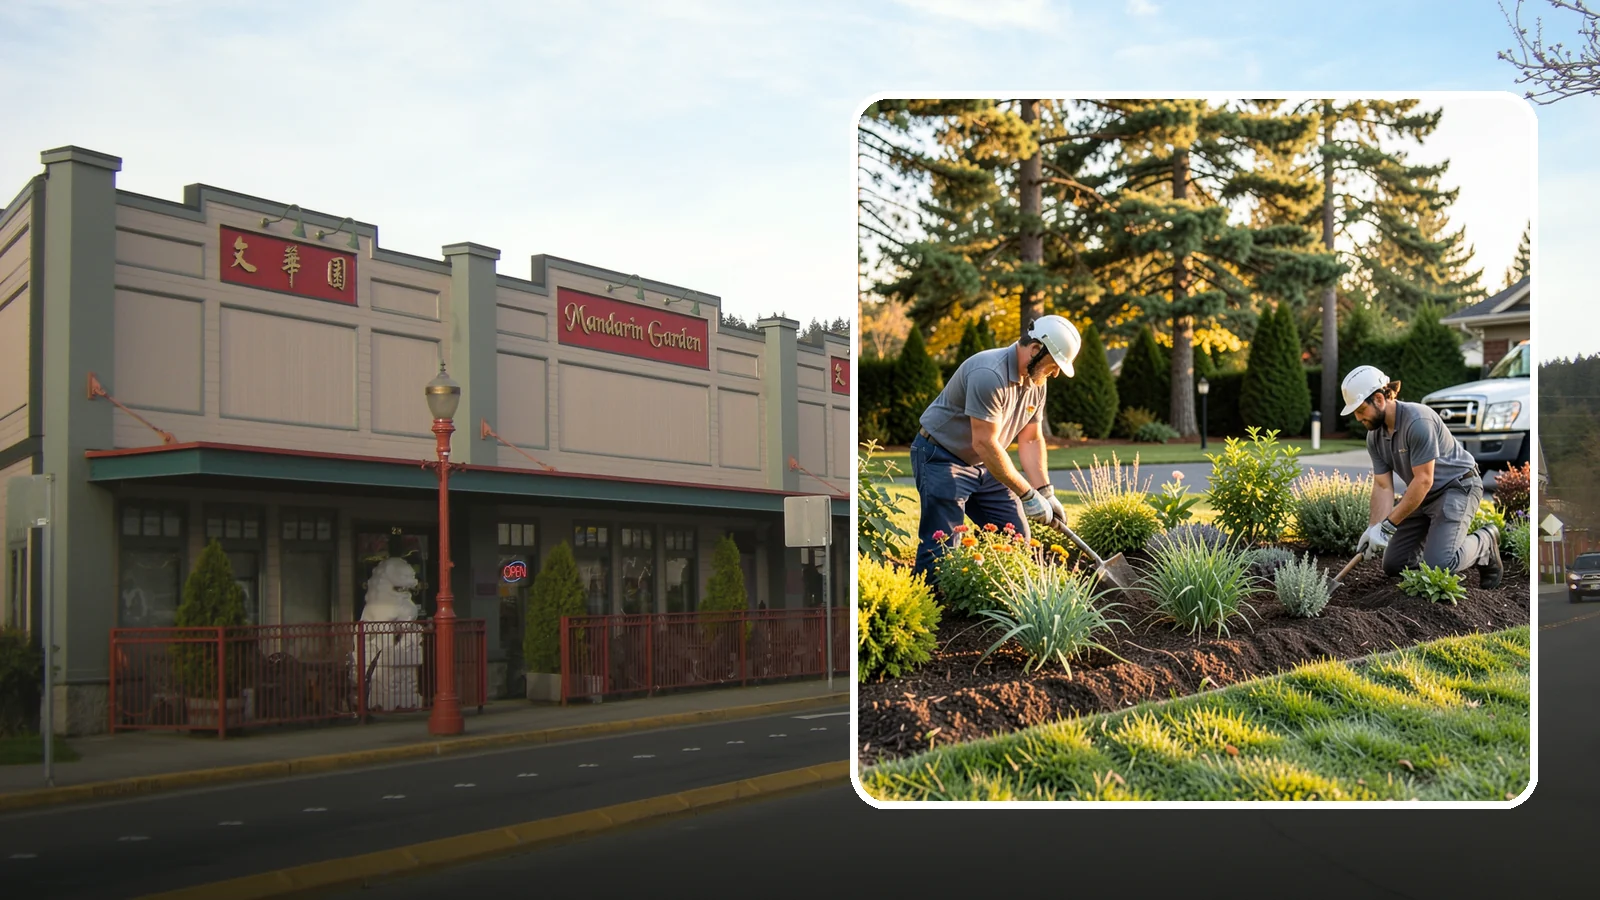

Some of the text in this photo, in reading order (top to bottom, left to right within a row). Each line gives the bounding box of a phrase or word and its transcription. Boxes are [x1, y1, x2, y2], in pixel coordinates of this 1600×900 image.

[564, 302, 701, 352] Mandarin Garden
[503, 565, 527, 578] OPEN
